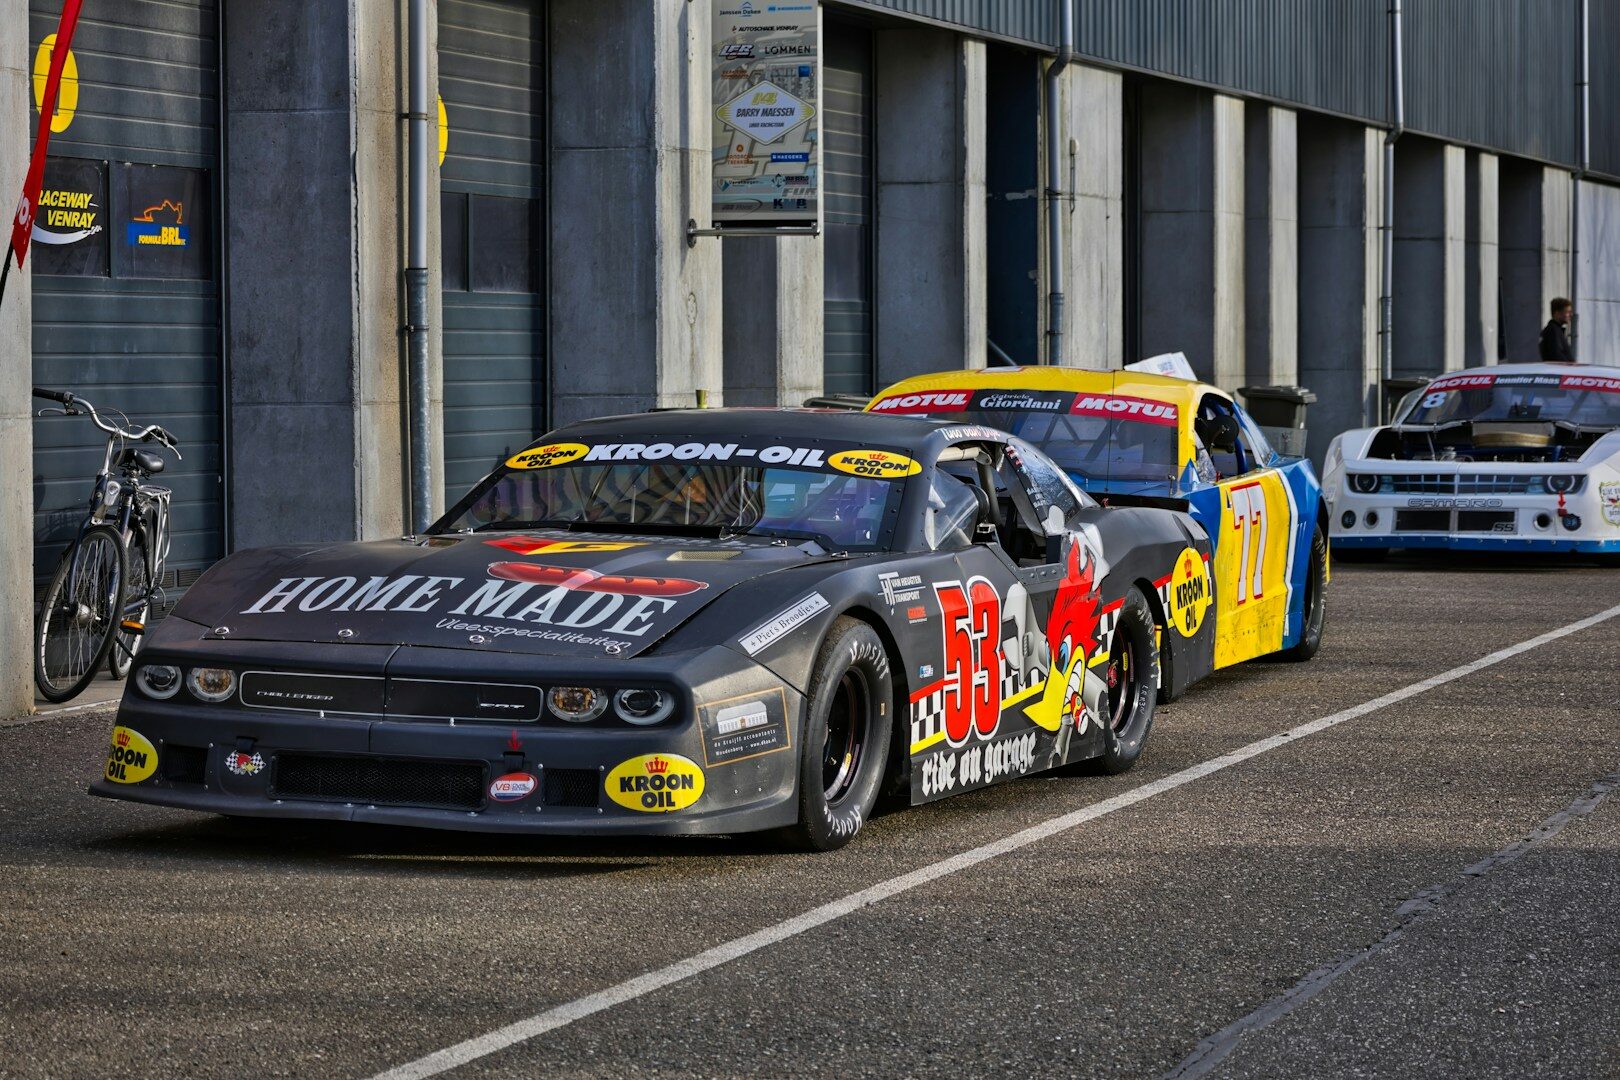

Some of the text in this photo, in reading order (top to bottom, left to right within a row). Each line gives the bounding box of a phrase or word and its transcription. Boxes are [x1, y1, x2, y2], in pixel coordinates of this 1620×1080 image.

[764, 45, 811, 55] LOMMEN
[736, 107, 795, 117] BARRY MAESSEN
[47, 209, 97, 229] VENRAY
[161, 226, 180, 245] BRL
[1430, 376, 1492, 390] MOTUL
[1494, 377, 1533, 385] Jennifer
[1563, 377, 1620, 389] MOTU
[872, 392, 968, 410] MOTUL
[979, 396, 1062, 410] Giordani
[1076, 398, 1178, 420] MOTUL
[1422, 391, 1447, 409] 8
[515, 449, 579, 464] KROON
[526, 458, 553, 468] OIL
[583, 442, 825, 468] KROON-OIL
[840, 456, 909, 471] KROON
[854, 465, 883, 476] OIL
[1407, 497, 1504, 508] CAMARO
[1492, 521, 1515, 533] SS
[1230, 481, 1269, 607] 77
[239, 575, 466, 614] HOME
[895, 590, 920, 603] TRANSPORT
[1175, 574, 1204, 610] KROON
[447, 578, 678, 638] MADE
[755, 604, 815, 644] Piet's Broodjes
[1185, 606, 1198, 633] OIL
[933, 576, 1001, 748] 53
[743, 729, 776, 741] accountants
[112, 745, 148, 769] OON
[921, 732, 1037, 797] ride on garage
[108, 761, 127, 781] OIL
[495, 783, 511, 792] V8
[619, 774, 694, 793] KROON
[641, 791, 676, 808] OIL
